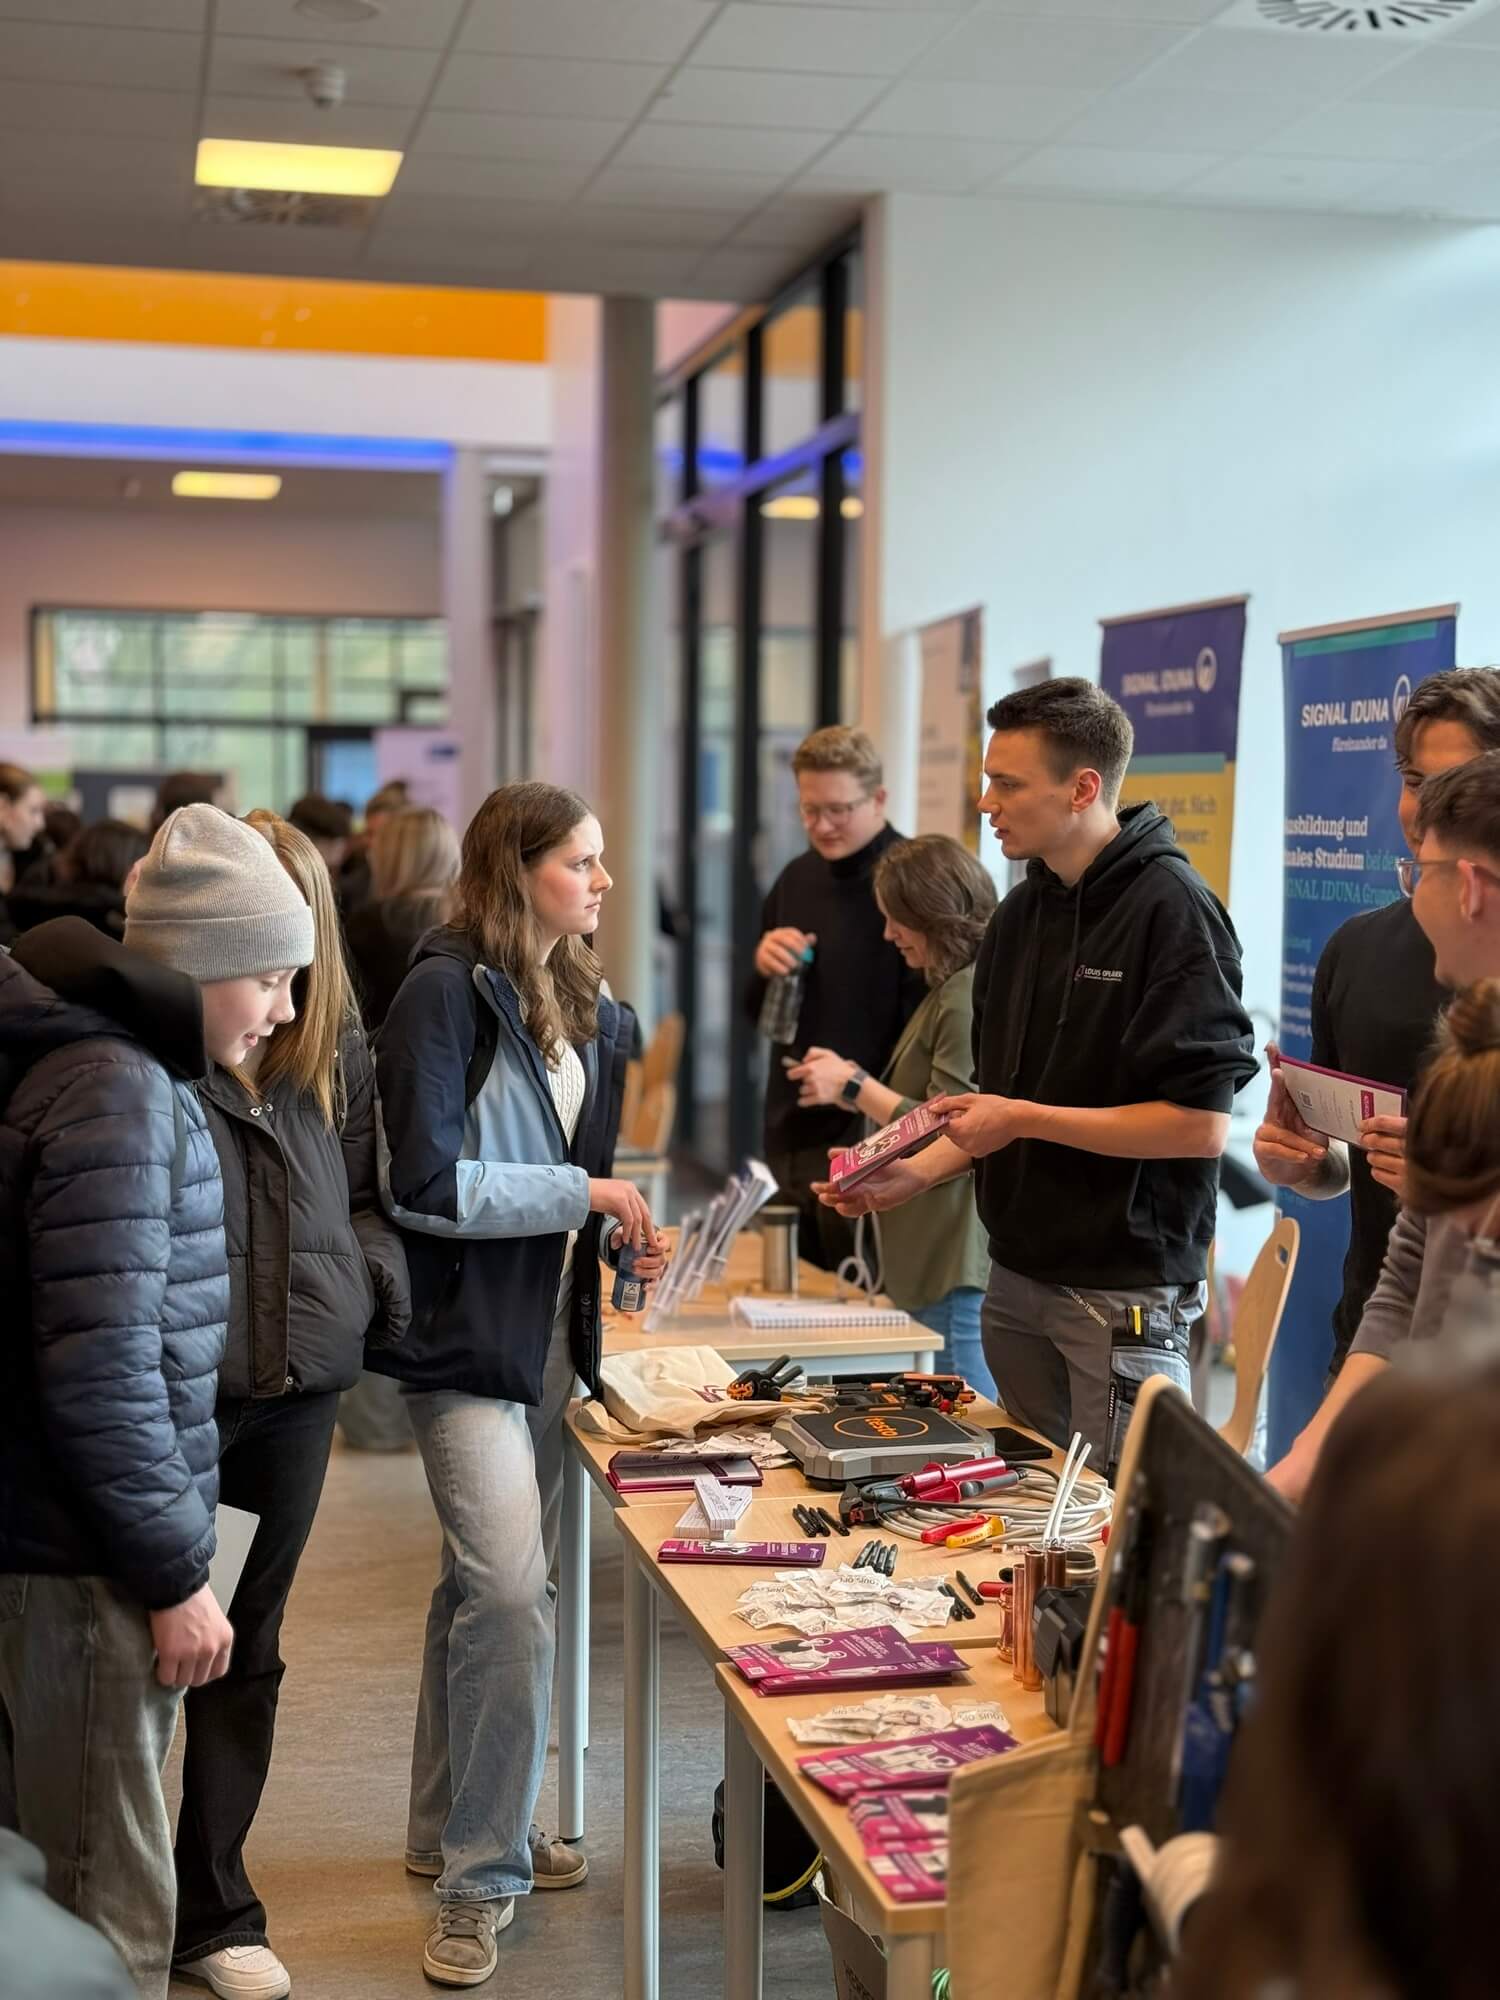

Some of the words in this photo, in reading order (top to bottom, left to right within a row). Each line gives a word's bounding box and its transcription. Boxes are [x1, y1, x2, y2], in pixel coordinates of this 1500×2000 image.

[1302, 702, 1348, 728] SIGNAL
[1350, 697, 1389, 724] IDUNA
[1346, 815, 1368, 836] und
[1315, 847, 1364, 870] Studium
[1321, 880, 1360, 903] IDUNA
[1084, 967, 1101, 976] LOUIS
[863, 1415, 898, 1437] testo
